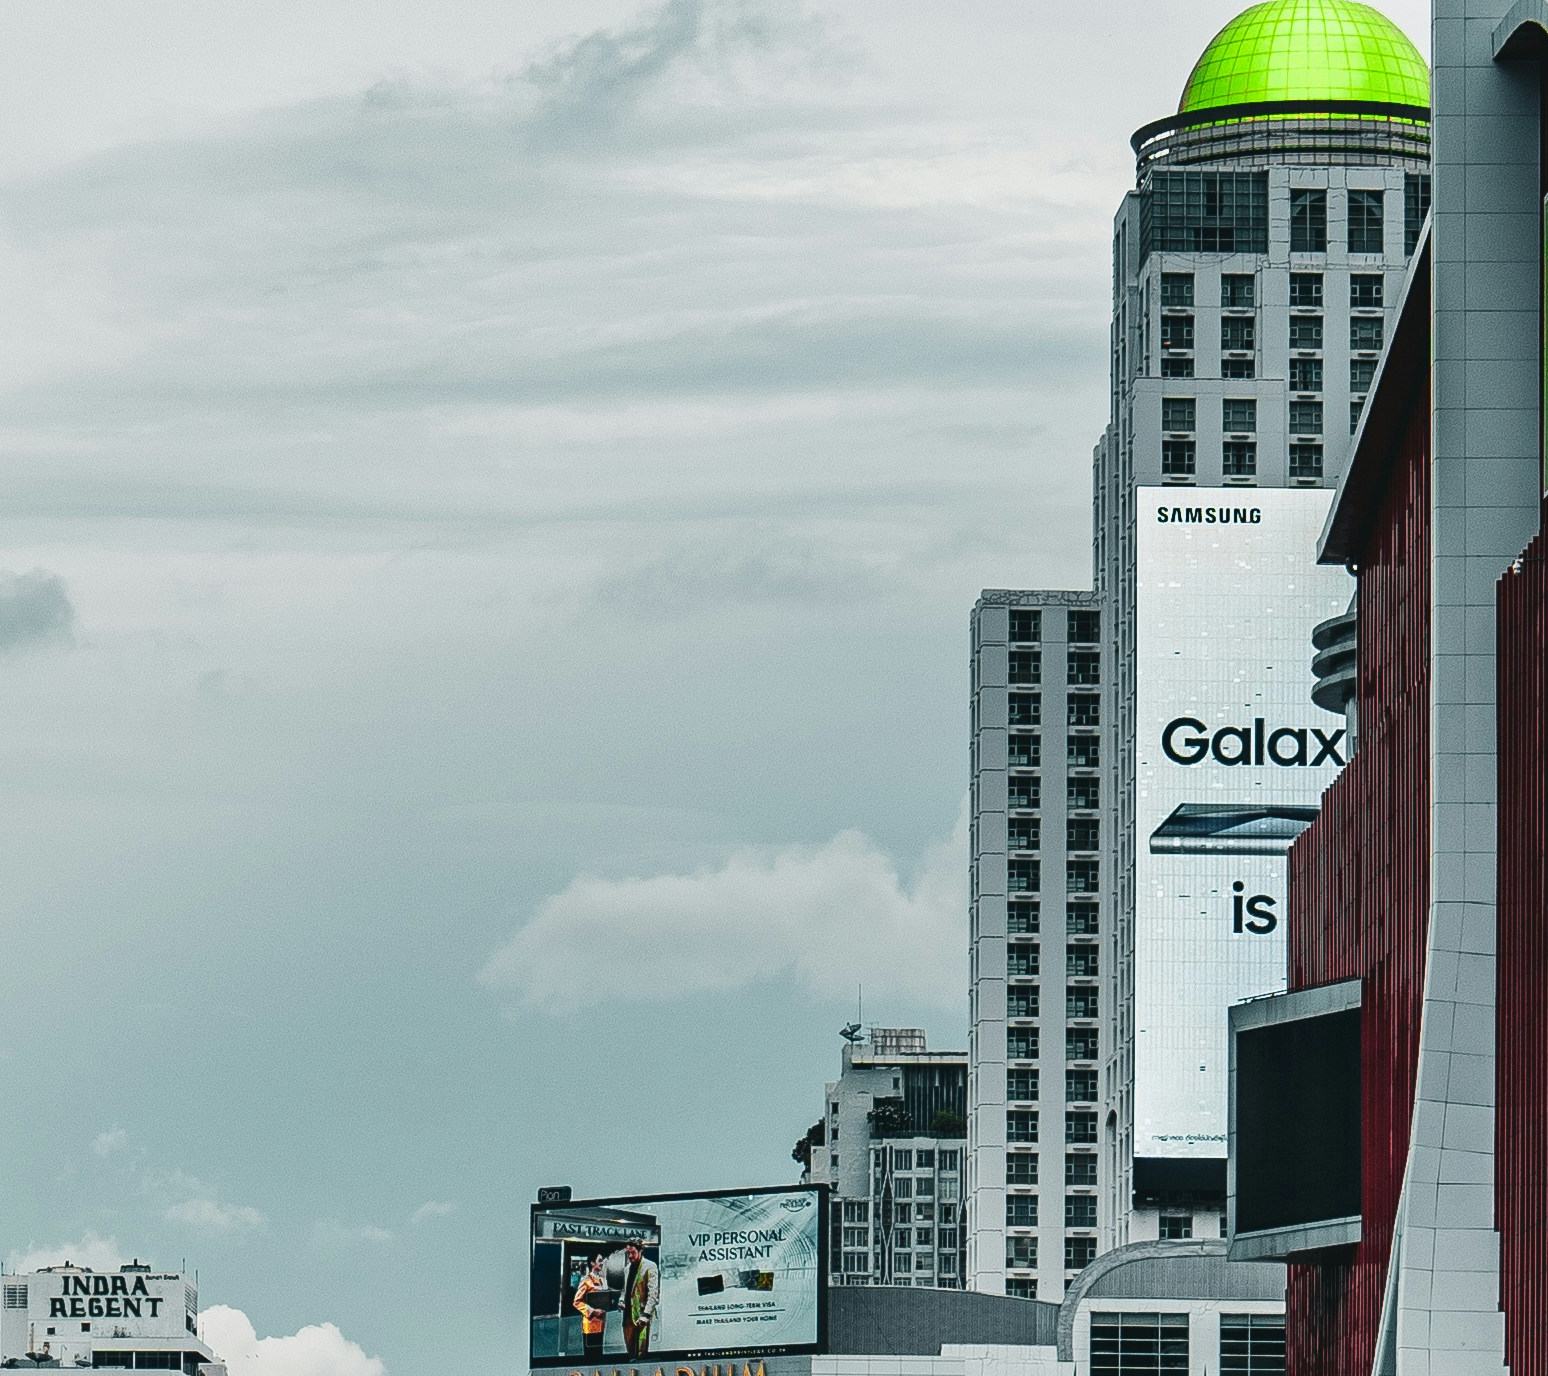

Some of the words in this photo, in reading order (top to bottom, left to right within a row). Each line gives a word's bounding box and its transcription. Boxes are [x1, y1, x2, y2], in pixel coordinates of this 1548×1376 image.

[1157, 507, 1261, 525] SAMSUNG
[1232, 881, 1277, 935] is
[554, 1222, 583, 1235] FAST
[586, 1225, 621, 1239] TRACK
[689, 1232, 711, 1247] VIP
[714, 1228, 787, 1246] PERSONAL
[698, 1246, 772, 1262] ASSISTANT
